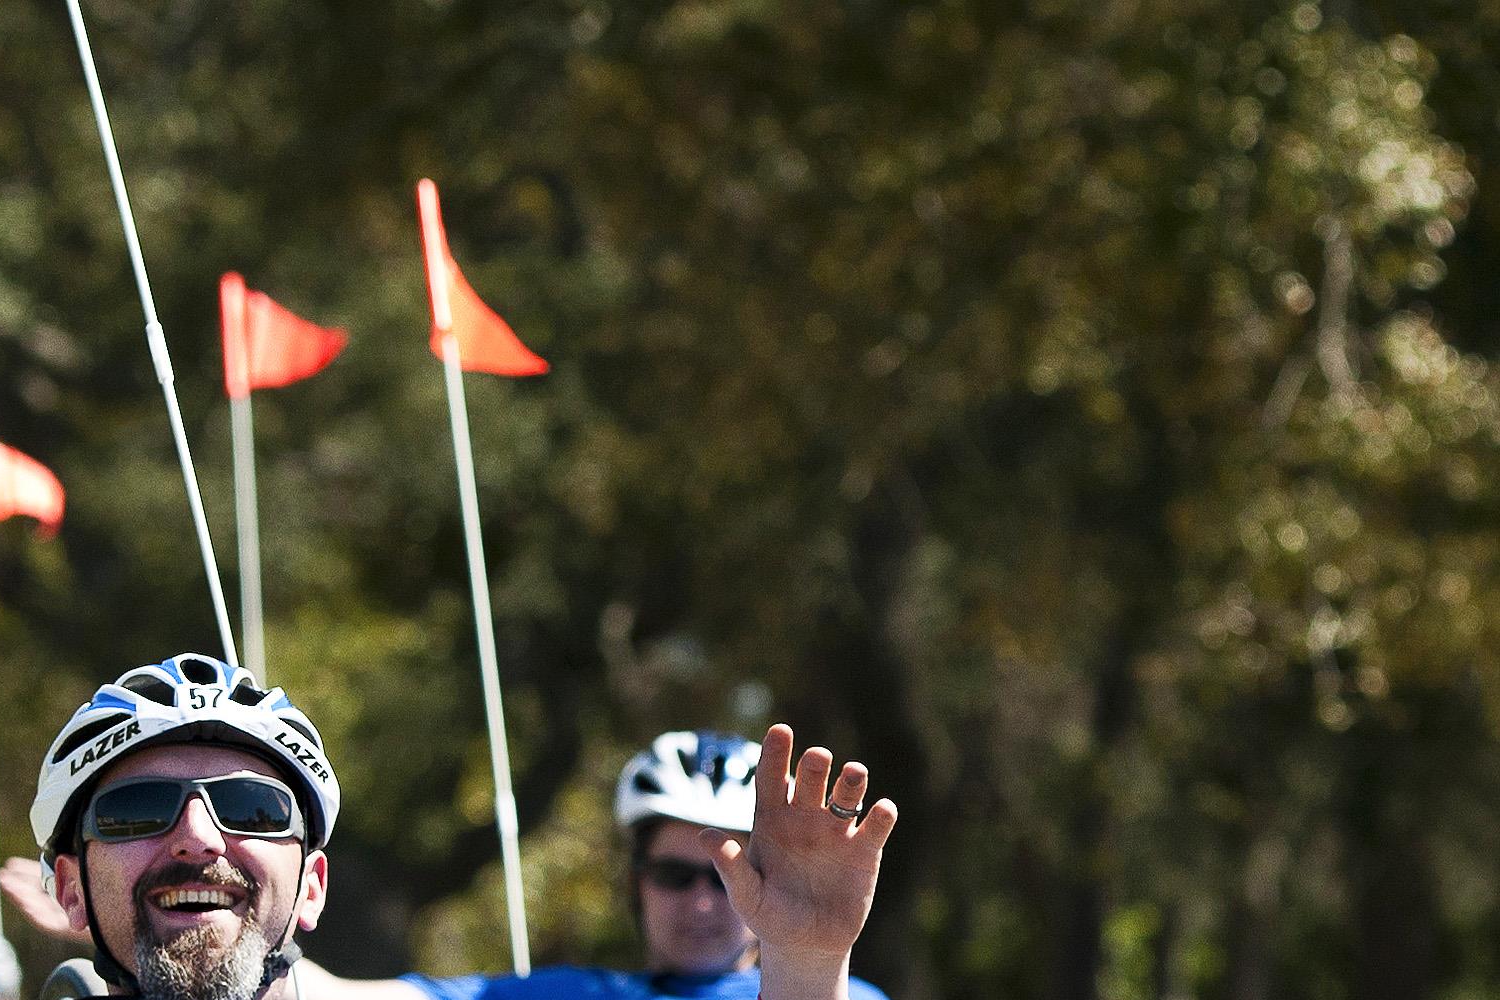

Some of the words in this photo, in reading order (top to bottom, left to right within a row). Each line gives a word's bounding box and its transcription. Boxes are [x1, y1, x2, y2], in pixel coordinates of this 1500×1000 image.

[190, 687, 223, 709] 57
[70, 720, 142, 777] LAZER
[274, 732, 329, 783] LAZER
